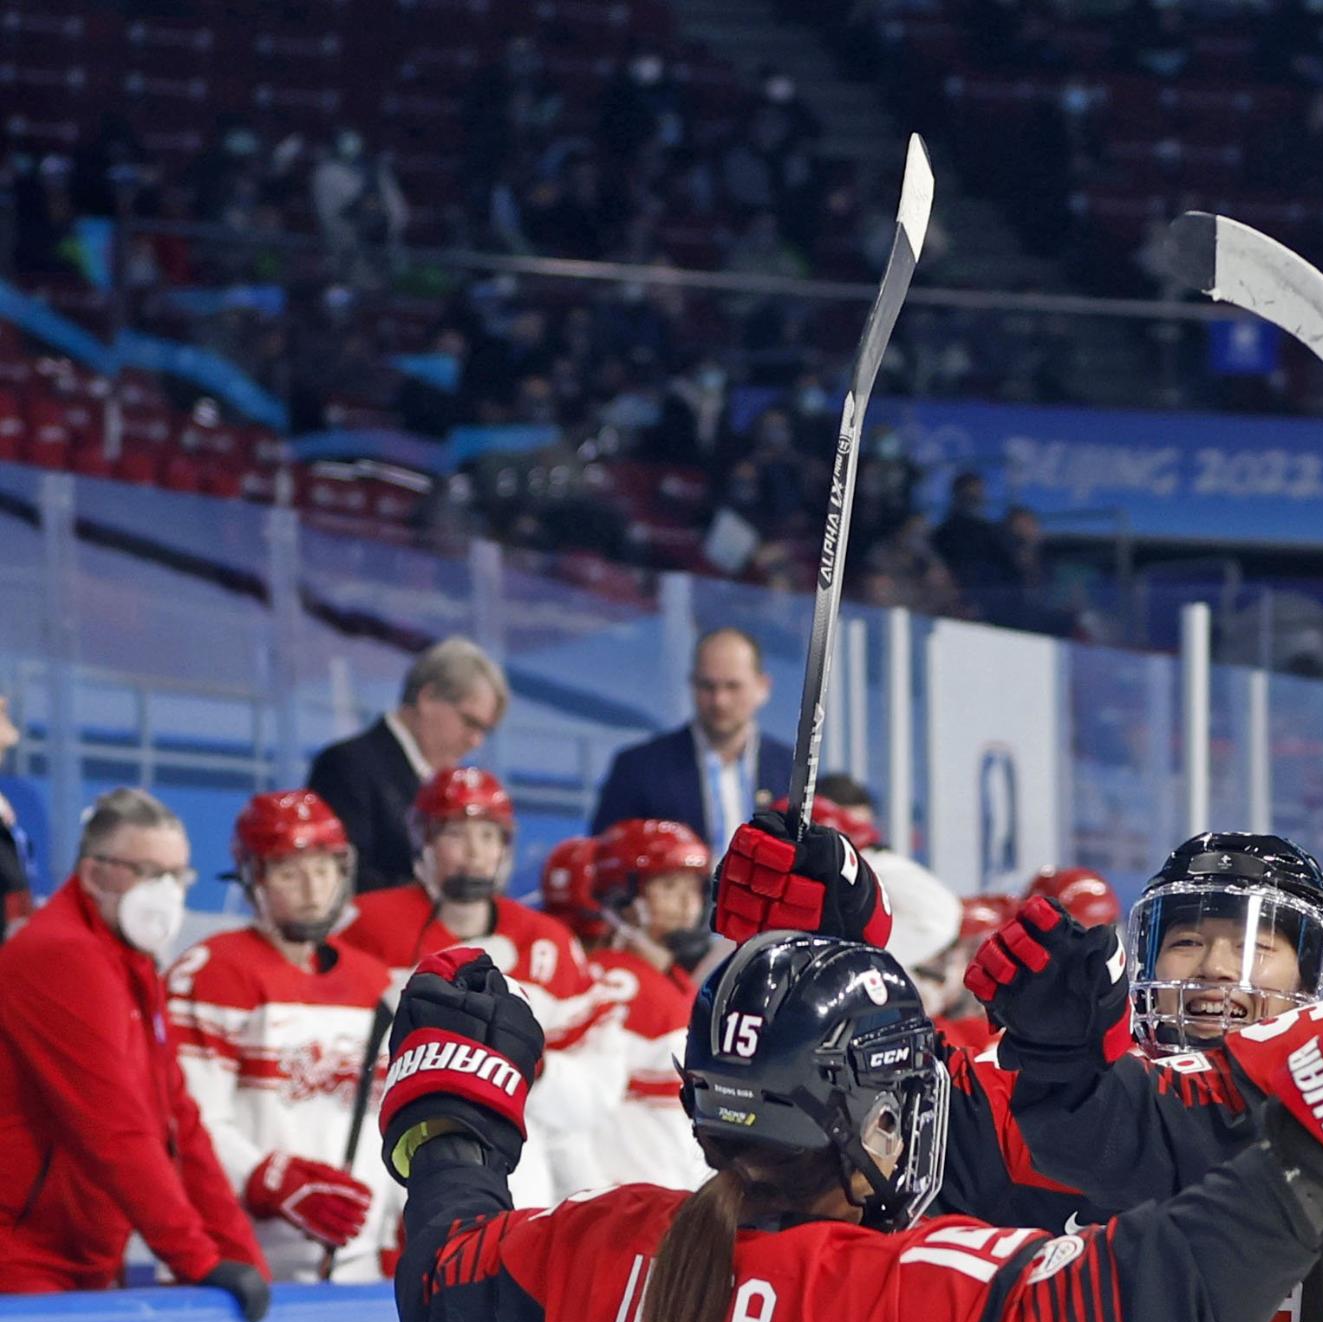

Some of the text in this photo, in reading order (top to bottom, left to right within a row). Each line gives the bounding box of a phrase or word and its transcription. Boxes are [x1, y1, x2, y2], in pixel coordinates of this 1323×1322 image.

[829, 479, 846, 513] LX
[819, 512, 841, 584] ALPHA
[722, 1010, 765, 1058] 15
[869, 1046, 910, 1069] CCM
